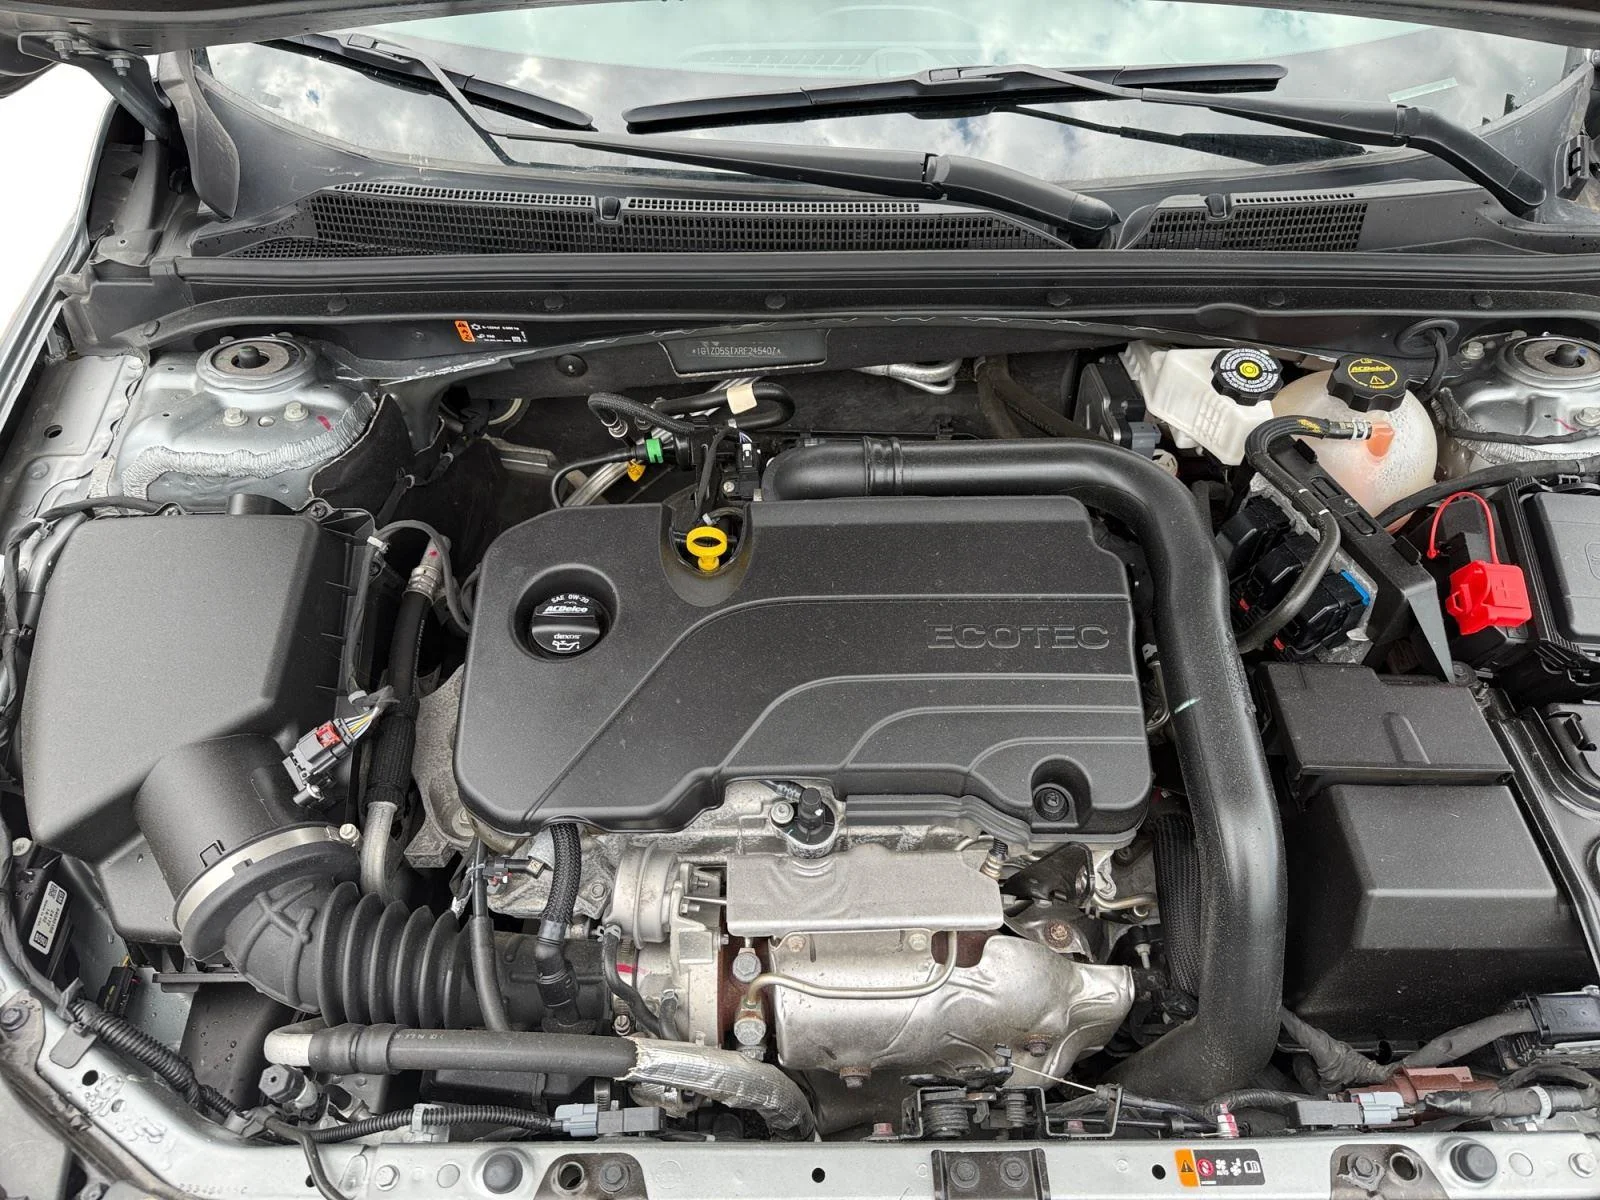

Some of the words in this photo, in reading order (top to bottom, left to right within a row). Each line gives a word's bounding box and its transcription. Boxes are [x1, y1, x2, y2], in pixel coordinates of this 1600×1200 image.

[551, 594, 565, 604] SAE
[568, 594, 590, 604] 0W-20
[543, 605, 589, 614] ACDelco
[927, 623, 1110, 650] ECOTEC
